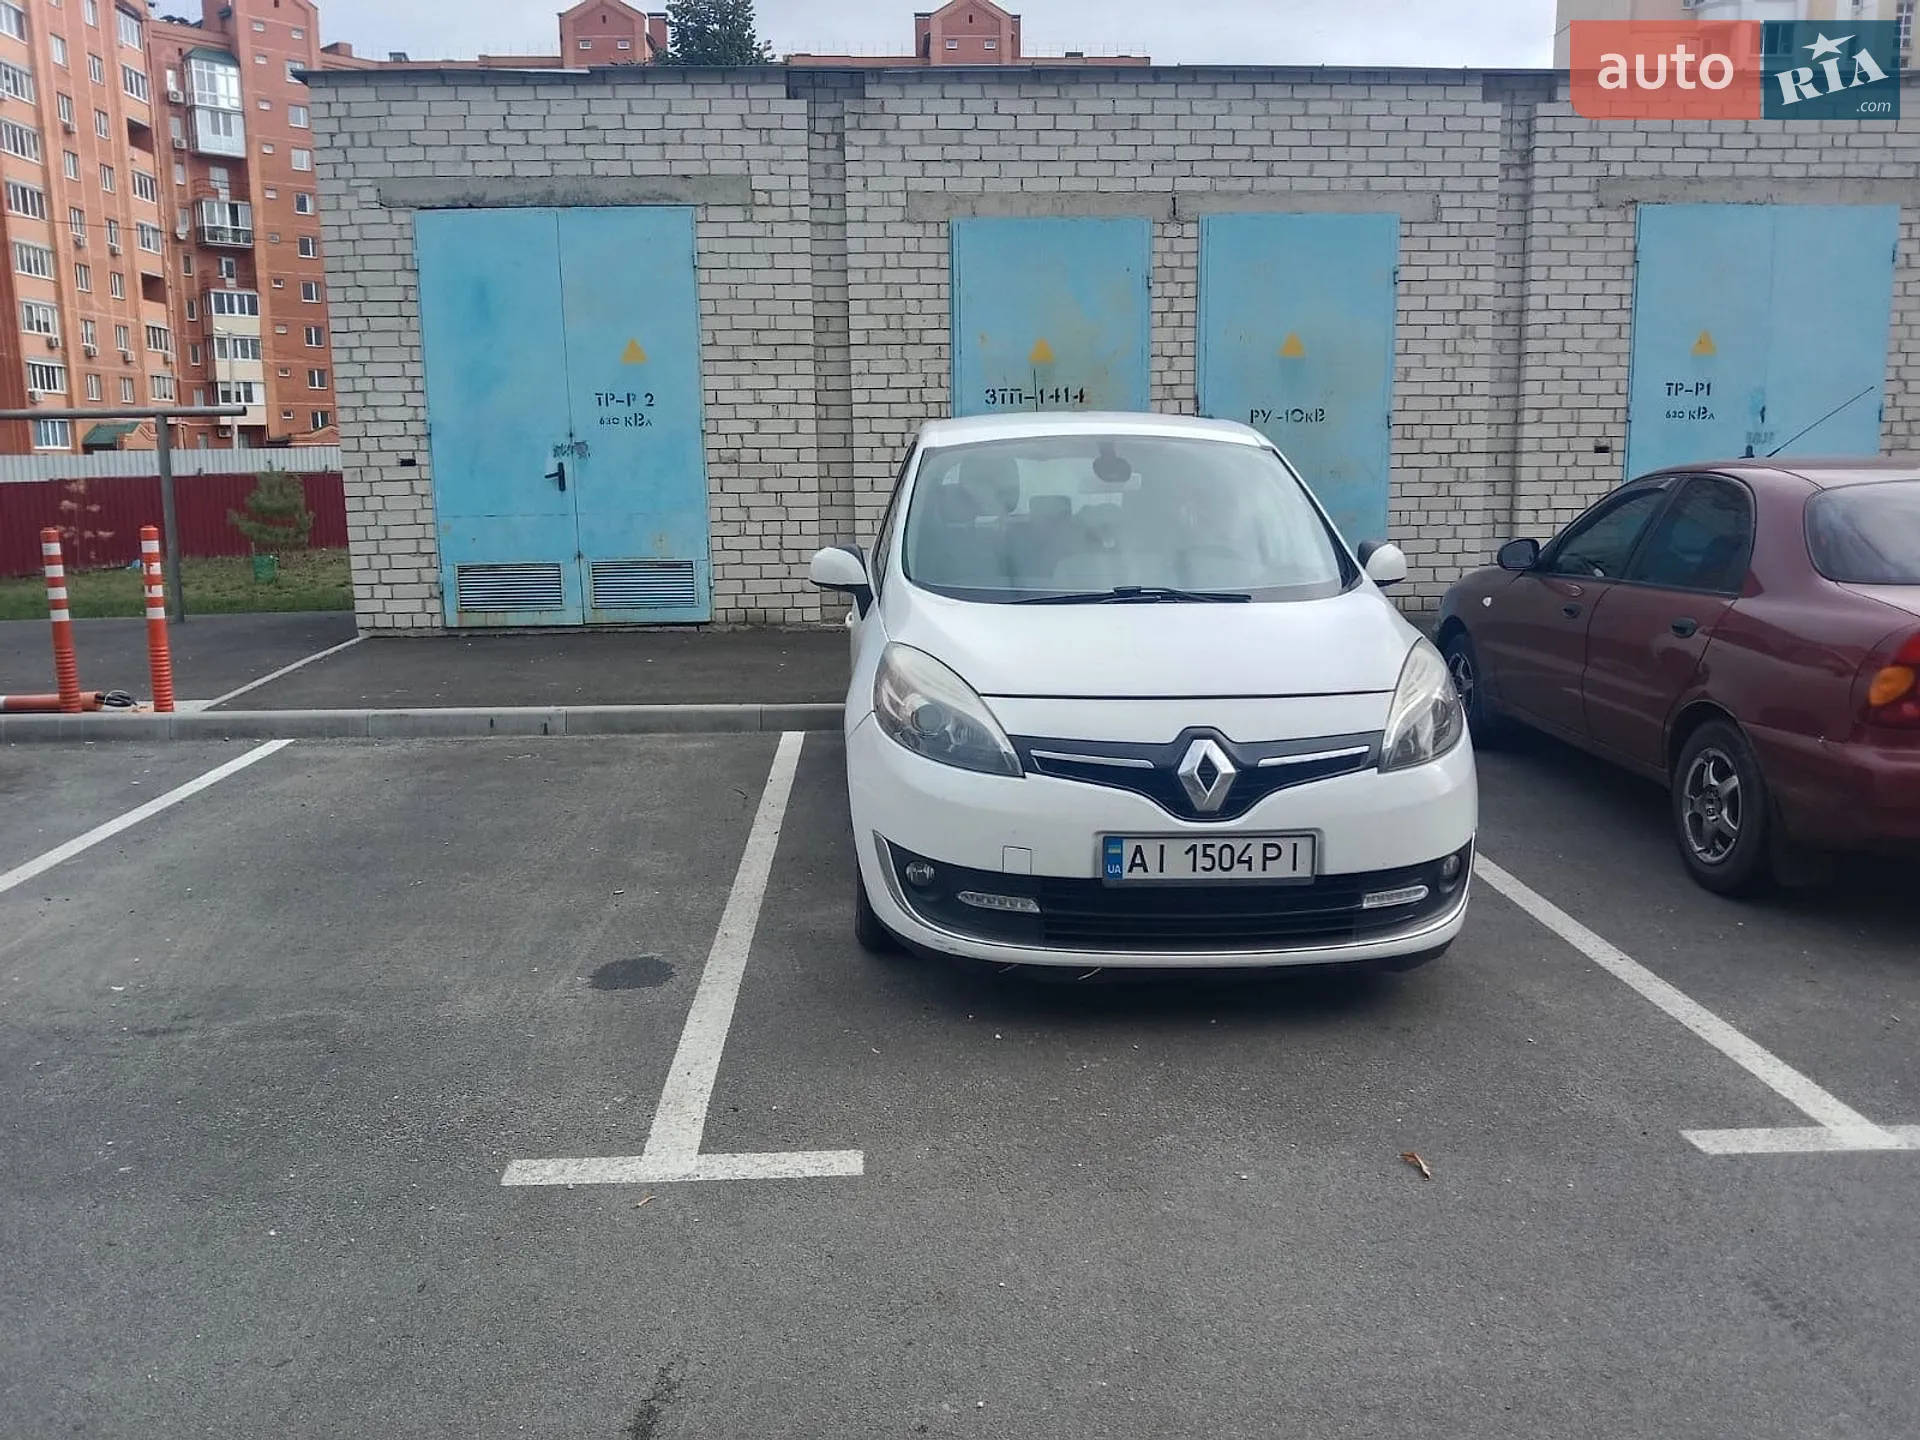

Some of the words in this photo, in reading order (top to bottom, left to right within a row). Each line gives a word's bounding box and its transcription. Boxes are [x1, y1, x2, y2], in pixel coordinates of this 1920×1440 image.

[1665, 410, 1685, 420] 630
[1127, 844, 1165, 873] AI
[1184, 843, 1253, 873] 1504
[1107, 865, 1121, 874] UA
